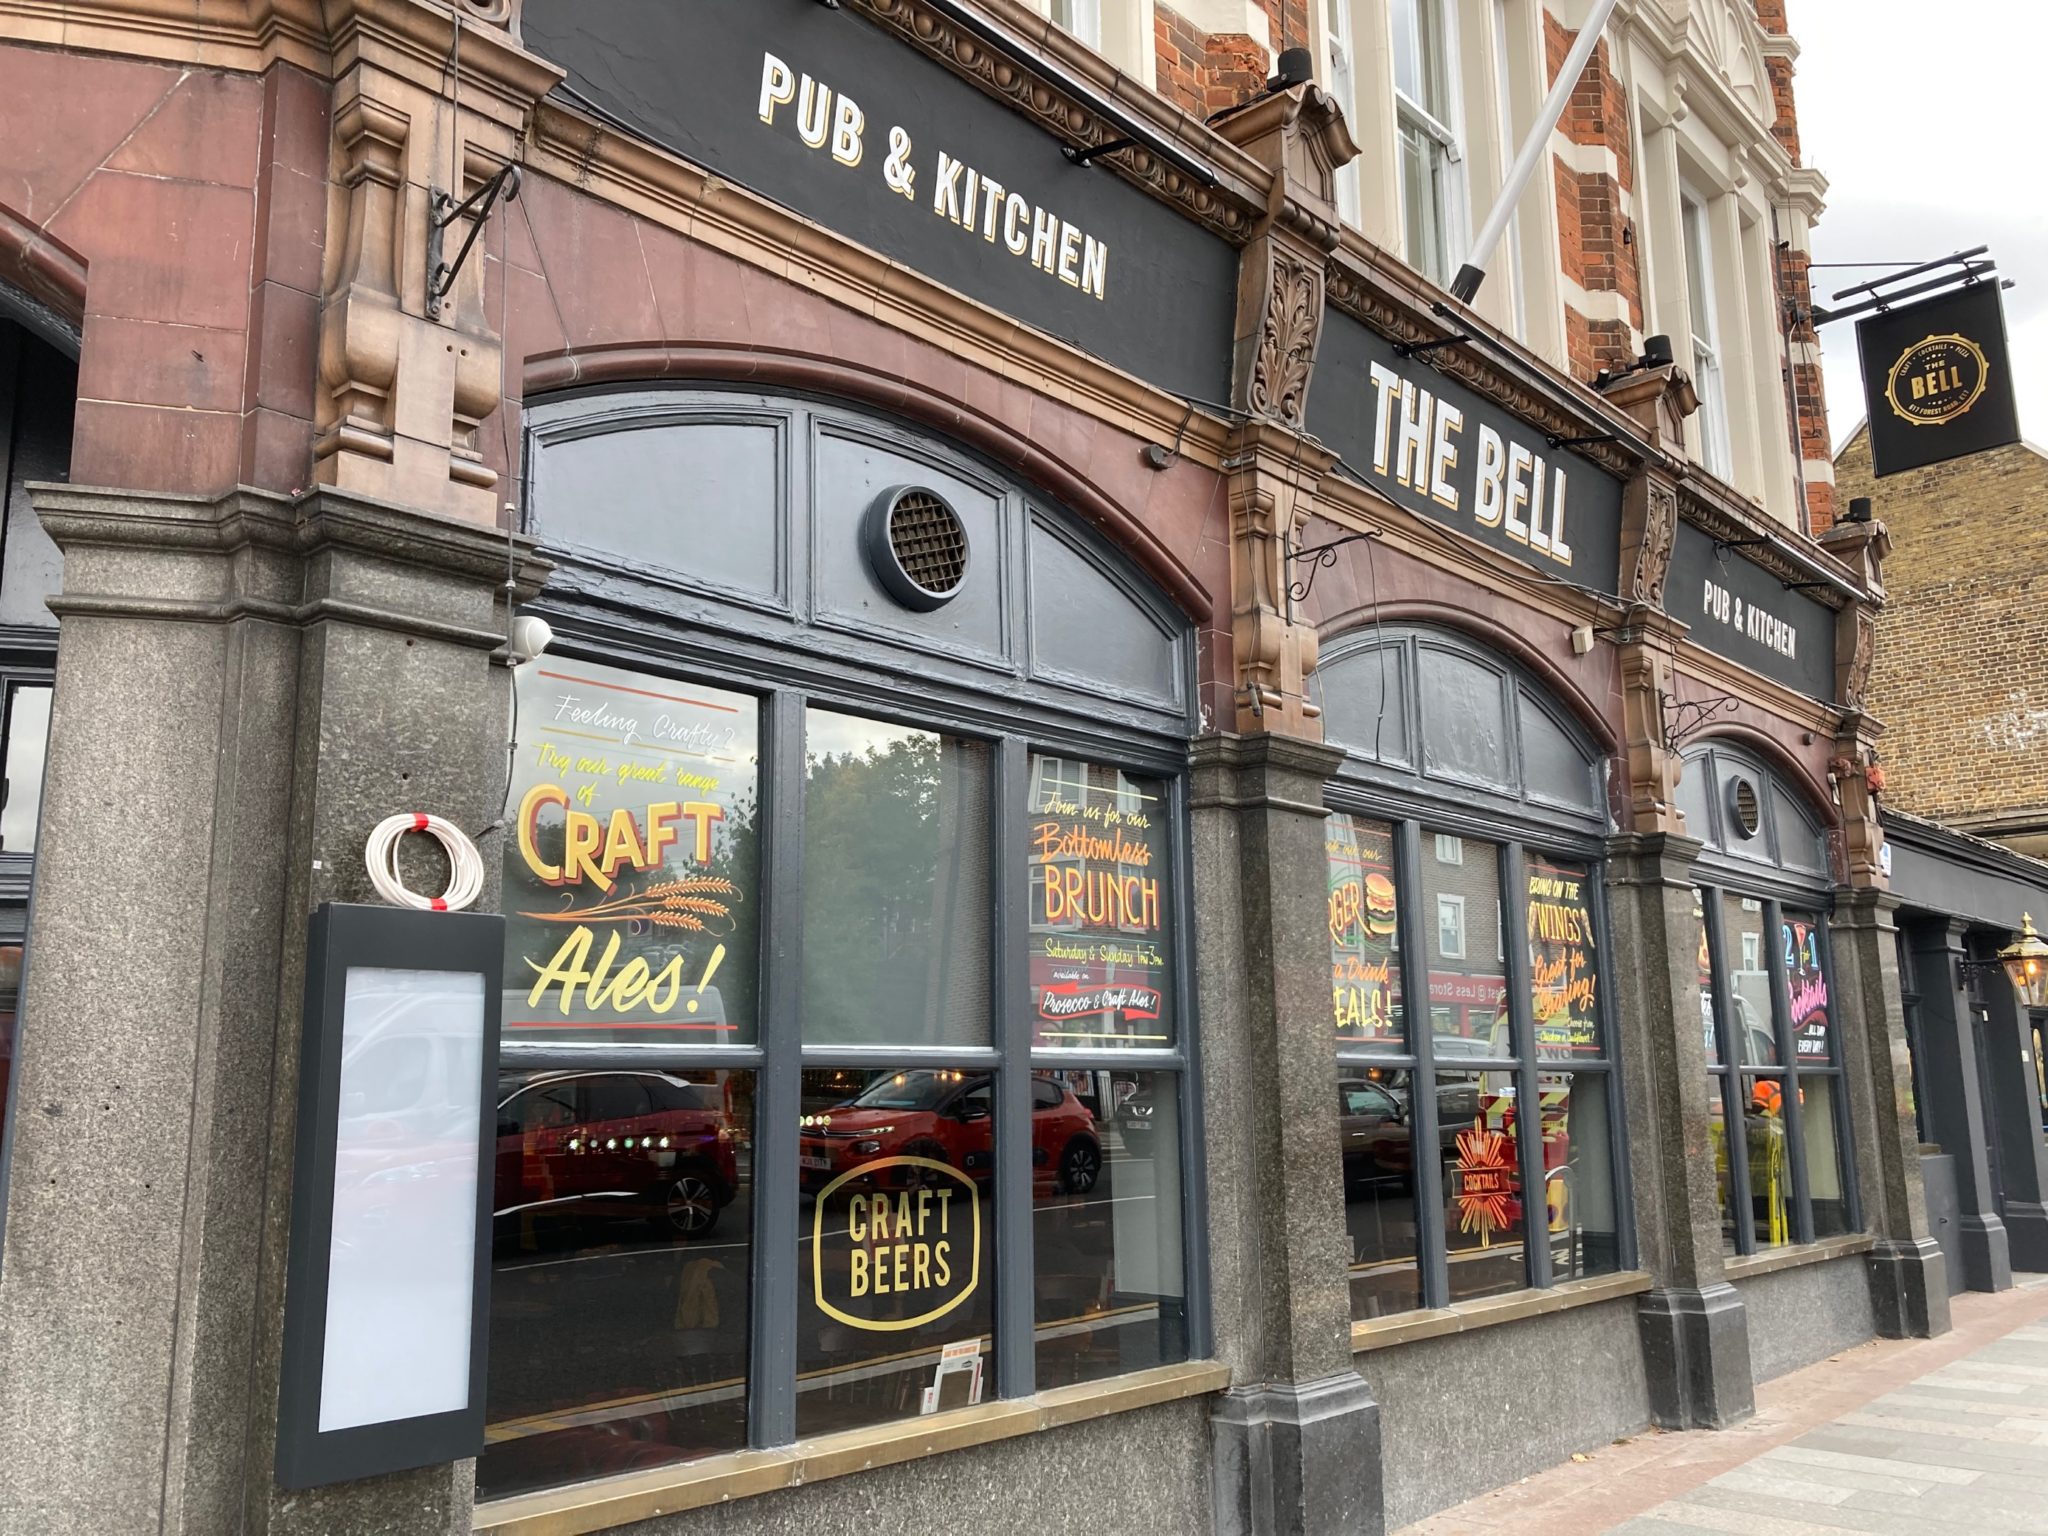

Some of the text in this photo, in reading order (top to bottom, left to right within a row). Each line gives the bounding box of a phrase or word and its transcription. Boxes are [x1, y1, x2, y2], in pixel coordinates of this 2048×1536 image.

[758, 51, 1107, 301] PUB & KITCHEN
[1900, 343, 1970, 376] CRAFT COCKTAILS PIZZA
[1924, 360, 1945, 370] THE
[1911, 366, 1963, 400] BELL
[1908, 403, 1920, 412] 617
[1370, 360, 1572, 566] THE BELL
[1704, 579, 1796, 660] PUB & KITCHEN
[555, 695, 734, 751] Feeling Crafty?
[532, 743, 718, 796] Try our great range
[577, 781, 600, 806] of
[1041, 790, 1151, 828] Join us for our
[517, 783, 726, 896] CRAFT
[1034, 822, 1153, 866] Bottomless
[1044, 863, 1160, 930] BRUNCH
[1529, 876, 1580, 900] BRING ON THE
[1535, 902, 1582, 943] WINGS
[1045, 938, 1087, 965] Saturday
[1089, 946, 1095, 960] &
[1100, 945, 1133, 968] Sunday
[1535, 946, 1587, 984] Great for
[1782, 924, 1795, 967] 2
[1808, 931, 1819, 969] 1
[523, 924, 726, 1015] Ales!
[1053, 969, 1079, 981] available
[1334, 955, 1389, 984] a Drink
[1043, 988, 1157, 1014] Prosecco & Craft Ales!
[1333, 985, 1393, 1028] EALS!
[1464, 1173, 1499, 1191] COCKTAILS
[849, 1188, 953, 1242] CRAFT
[850, 1240, 951, 1297] BEERS
